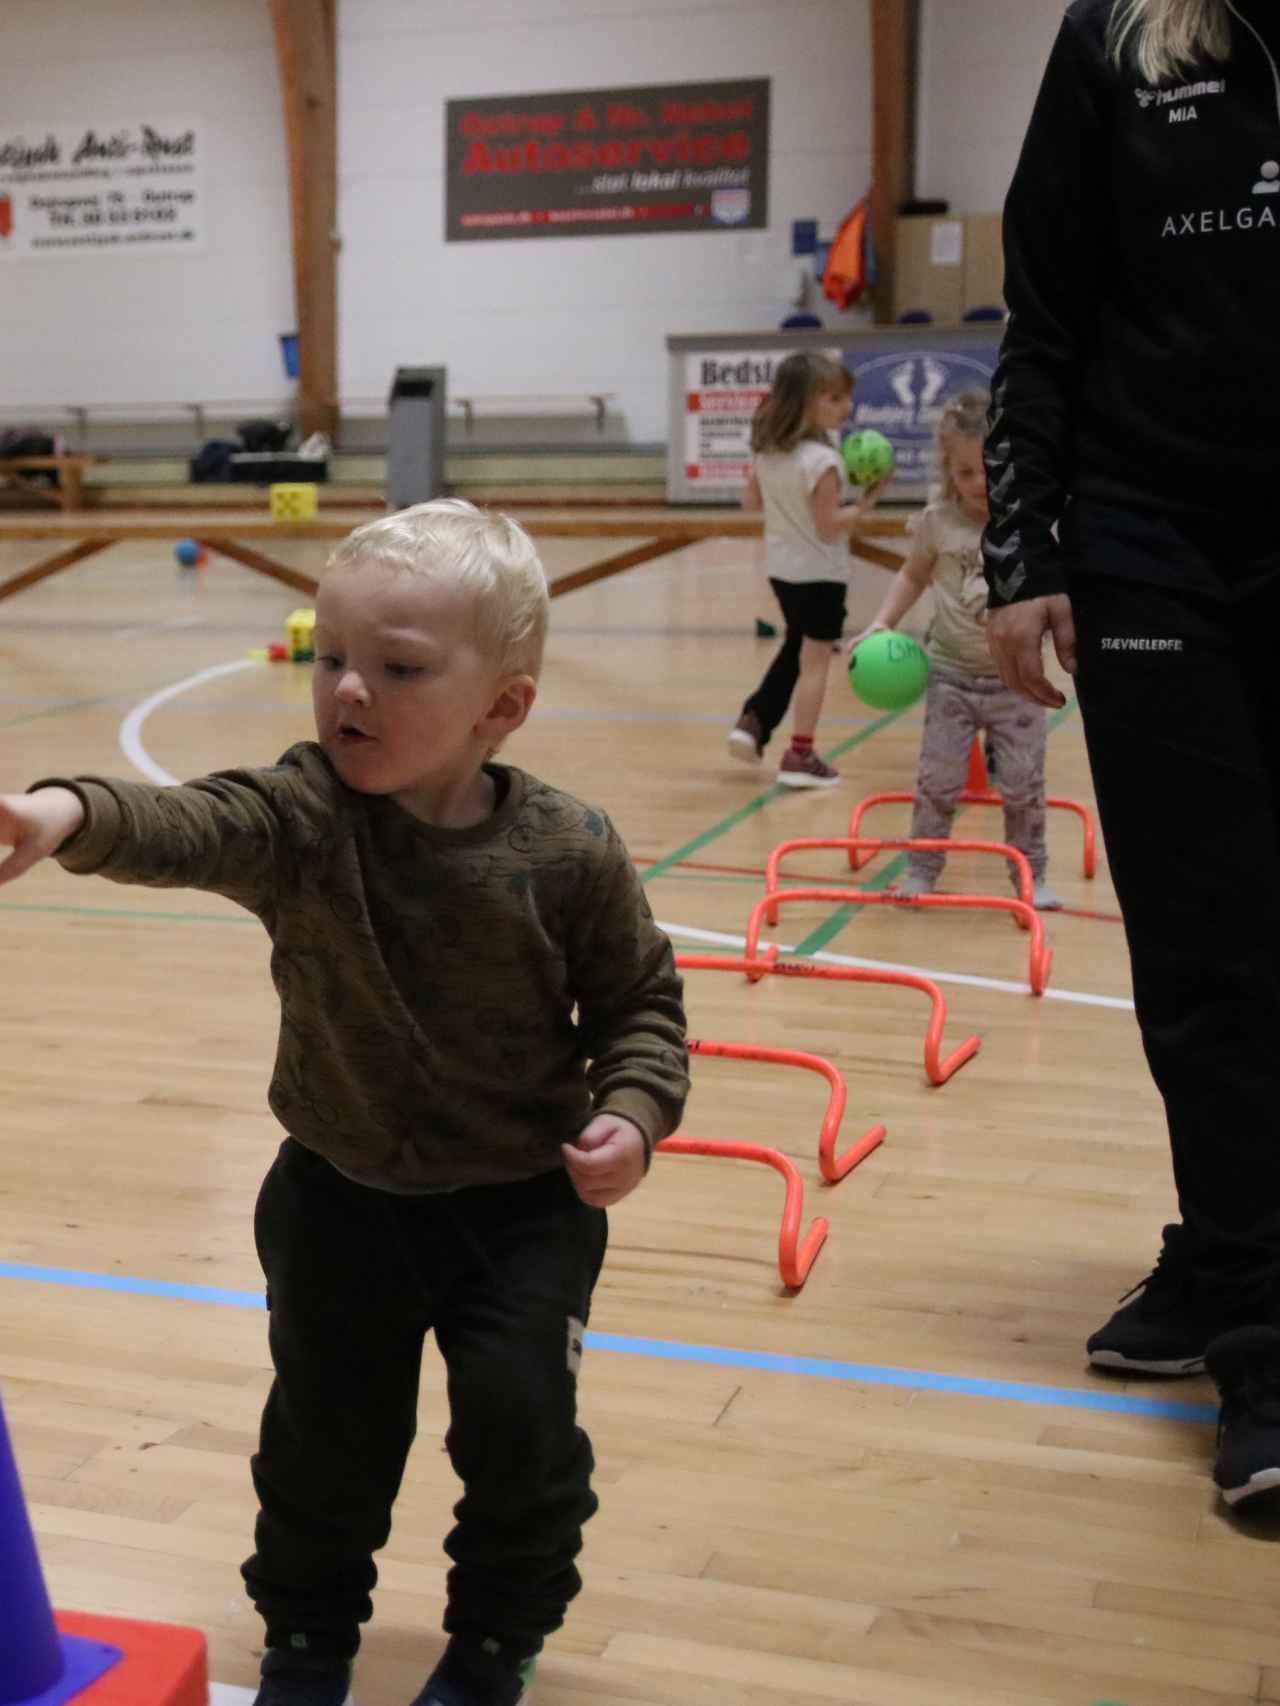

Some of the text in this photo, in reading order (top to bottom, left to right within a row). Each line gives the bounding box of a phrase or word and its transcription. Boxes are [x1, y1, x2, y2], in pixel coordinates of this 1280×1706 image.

[1155, 79, 1226, 107] hummel
[1168, 105, 1198, 124] MIA
[463, 129, 751, 176] Autoservice
[1161, 205, 1280, 238] AXELGA
